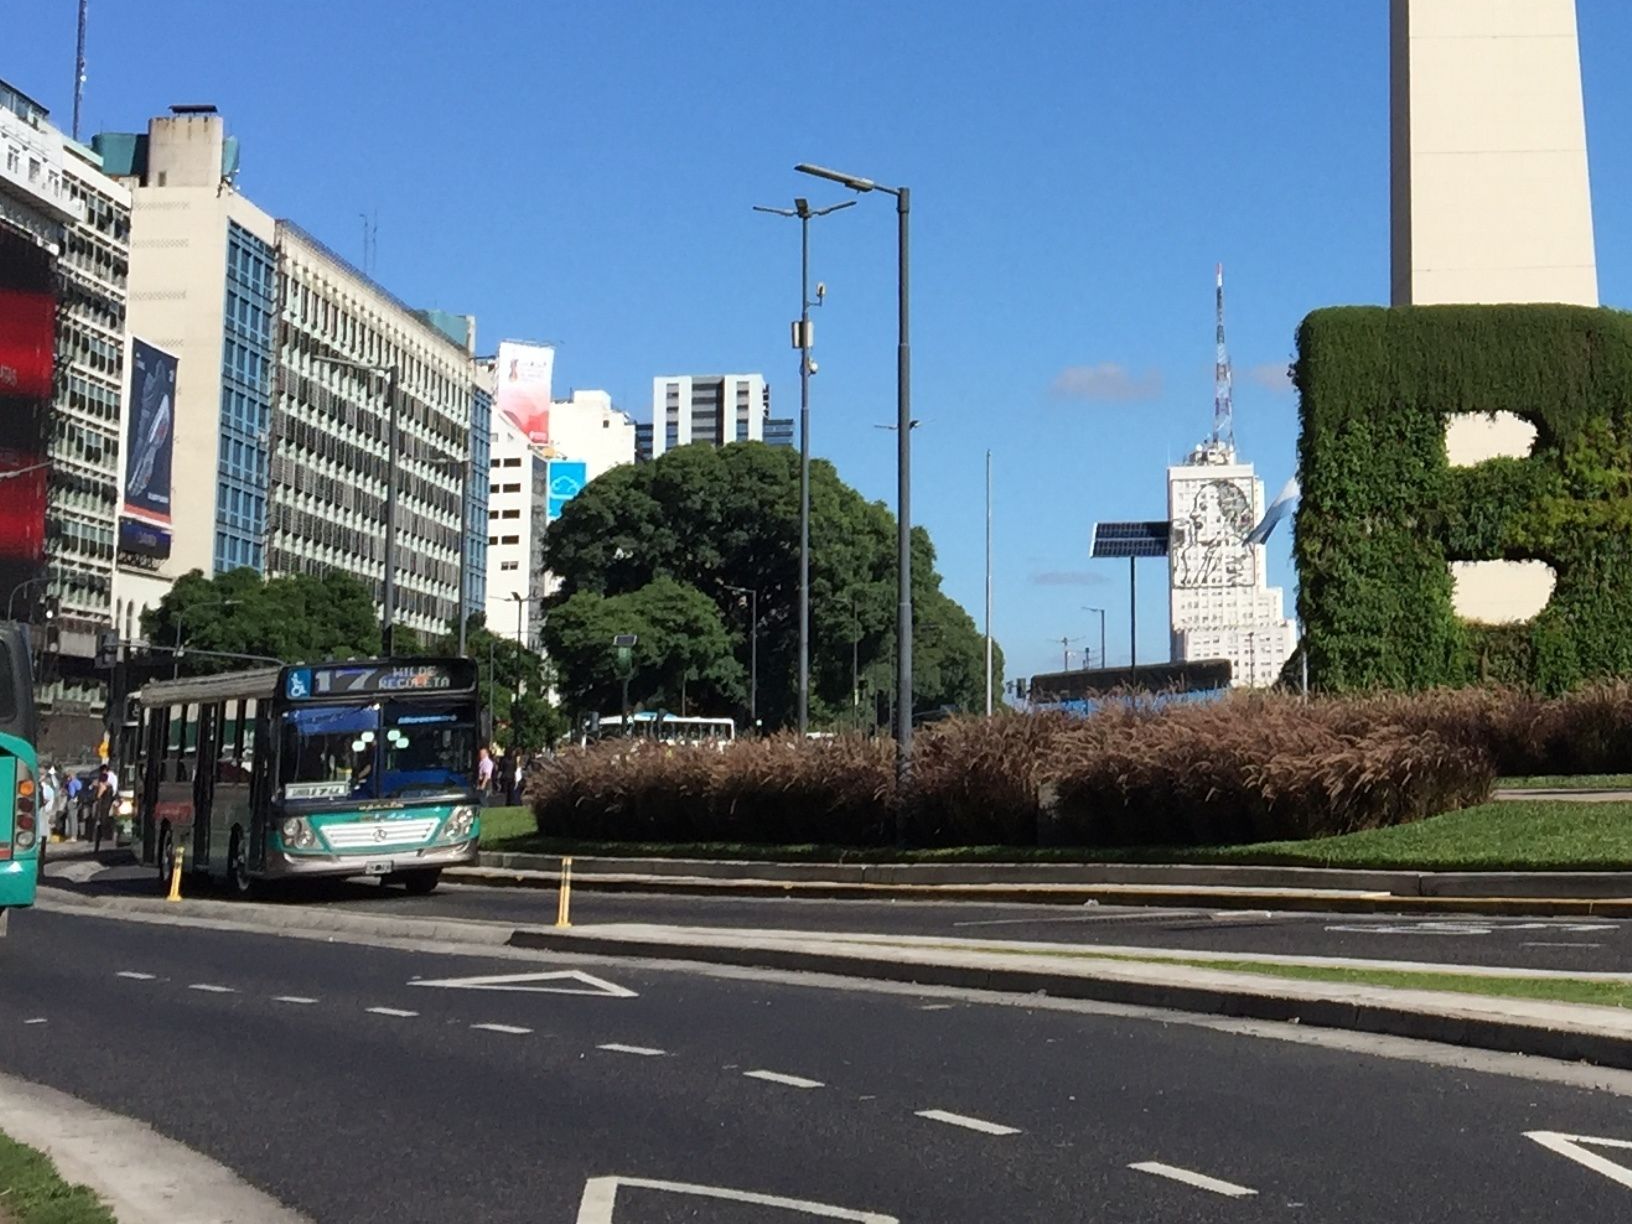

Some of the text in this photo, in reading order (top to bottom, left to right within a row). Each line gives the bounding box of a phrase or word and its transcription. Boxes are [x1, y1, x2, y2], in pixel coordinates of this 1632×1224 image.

[392, 666, 437, 678] WILDE
[315, 668, 378, 692] 17
[378, 675, 450, 690] RECOLETA
